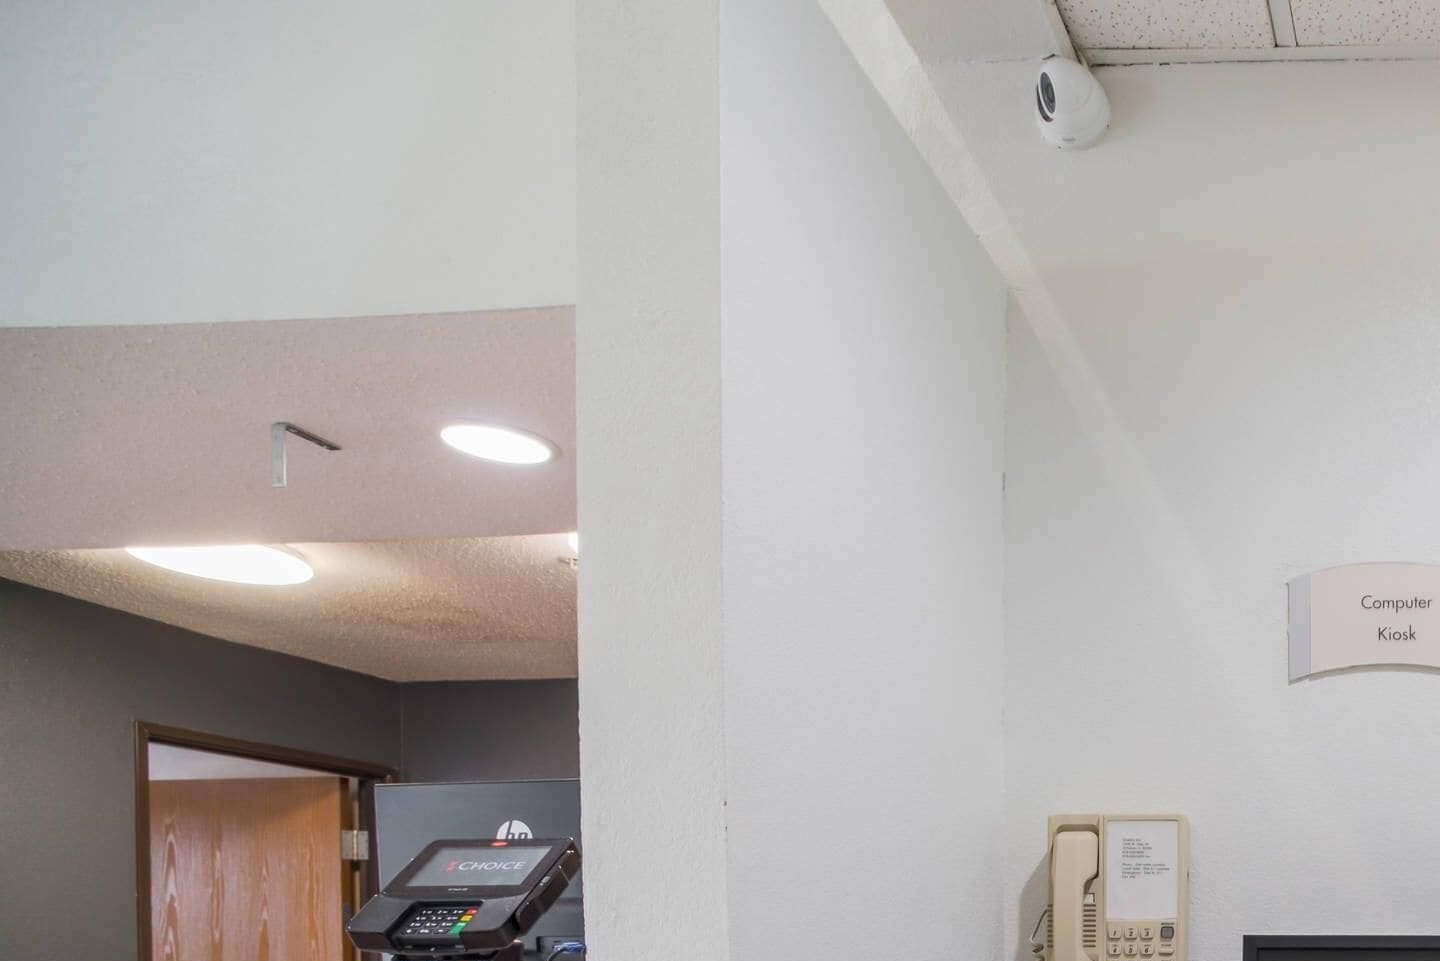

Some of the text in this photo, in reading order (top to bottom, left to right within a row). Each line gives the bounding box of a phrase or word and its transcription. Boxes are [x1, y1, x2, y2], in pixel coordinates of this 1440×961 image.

[1361, 595, 1432, 612] Computer
[1378, 624, 1416, 641] Kiosk
[458, 861, 526, 871] CHOICE
